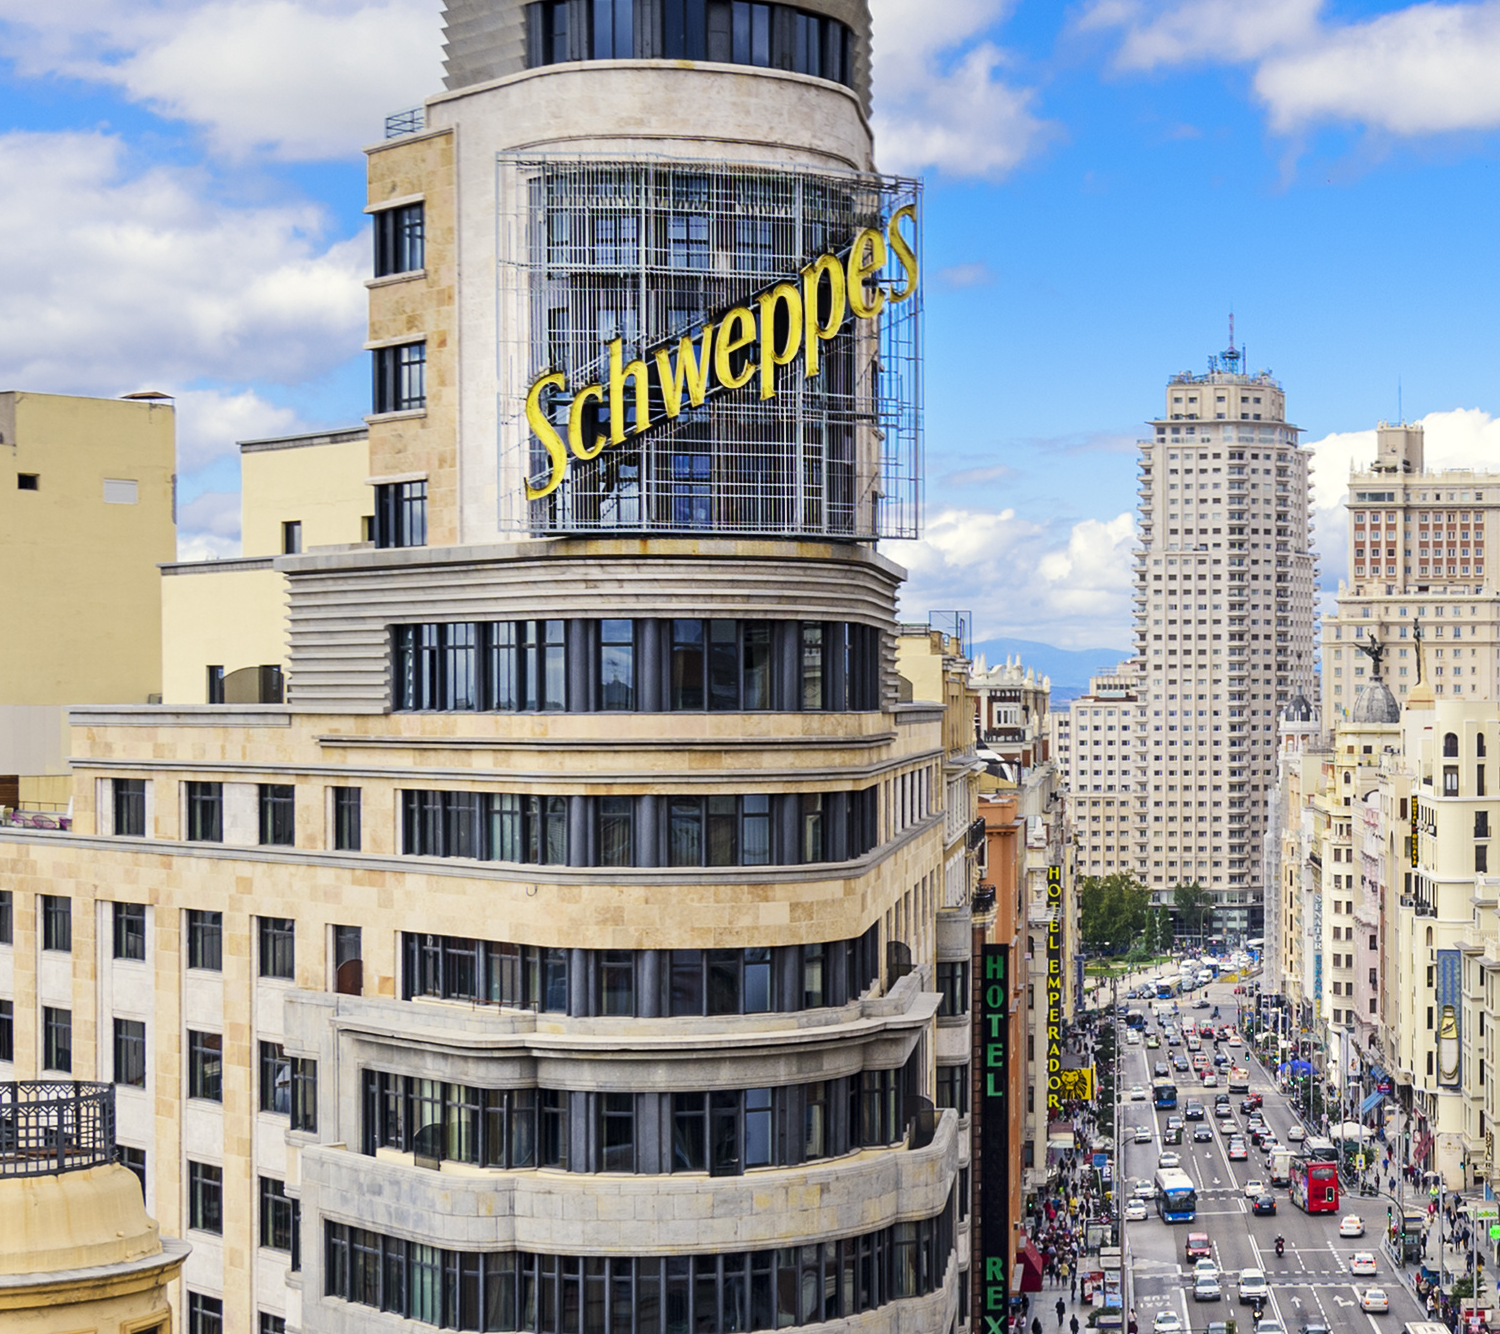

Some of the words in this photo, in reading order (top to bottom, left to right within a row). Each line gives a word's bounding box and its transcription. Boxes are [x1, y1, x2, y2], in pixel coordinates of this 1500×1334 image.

[524, 204, 918, 501] Schweppes
[1048, 867, 1061, 950] HOTEL
[986, 954, 1005, 1097] HOTEL
[1047, 959, 1061, 1108] EMPERADOR
